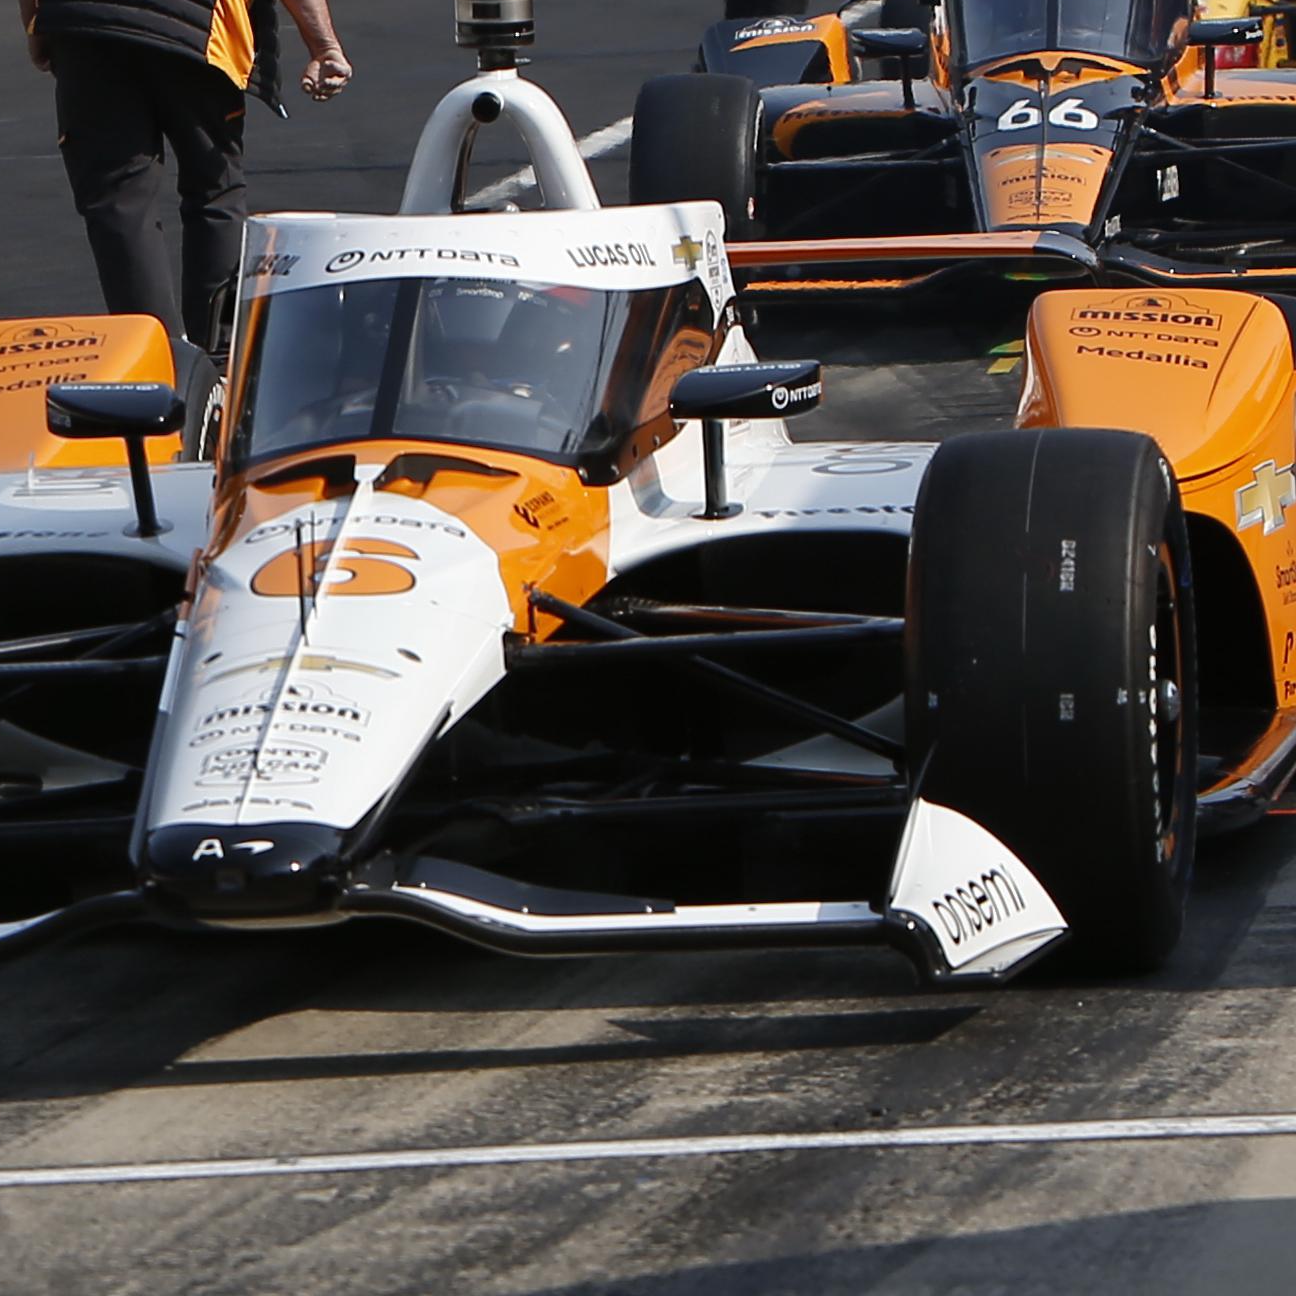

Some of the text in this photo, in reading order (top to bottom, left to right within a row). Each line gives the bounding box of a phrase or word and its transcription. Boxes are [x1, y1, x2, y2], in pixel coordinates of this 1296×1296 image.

[739, 24, 813, 39] mission
[997, 98, 1099, 131] 66
[370, 248, 435, 263] NTT
[566, 243, 657, 268] LUCAS OIL
[1078, 310, 1214, 327] mission
[1107, 330, 1153, 340] NTT
[1077, 345, 1208, 370] Medallia
[790, 385, 808, 402] NTT
[251, 537, 421, 597] 6
[205, 701, 361, 725] mission
[932, 865, 1026, 945] onsemi
